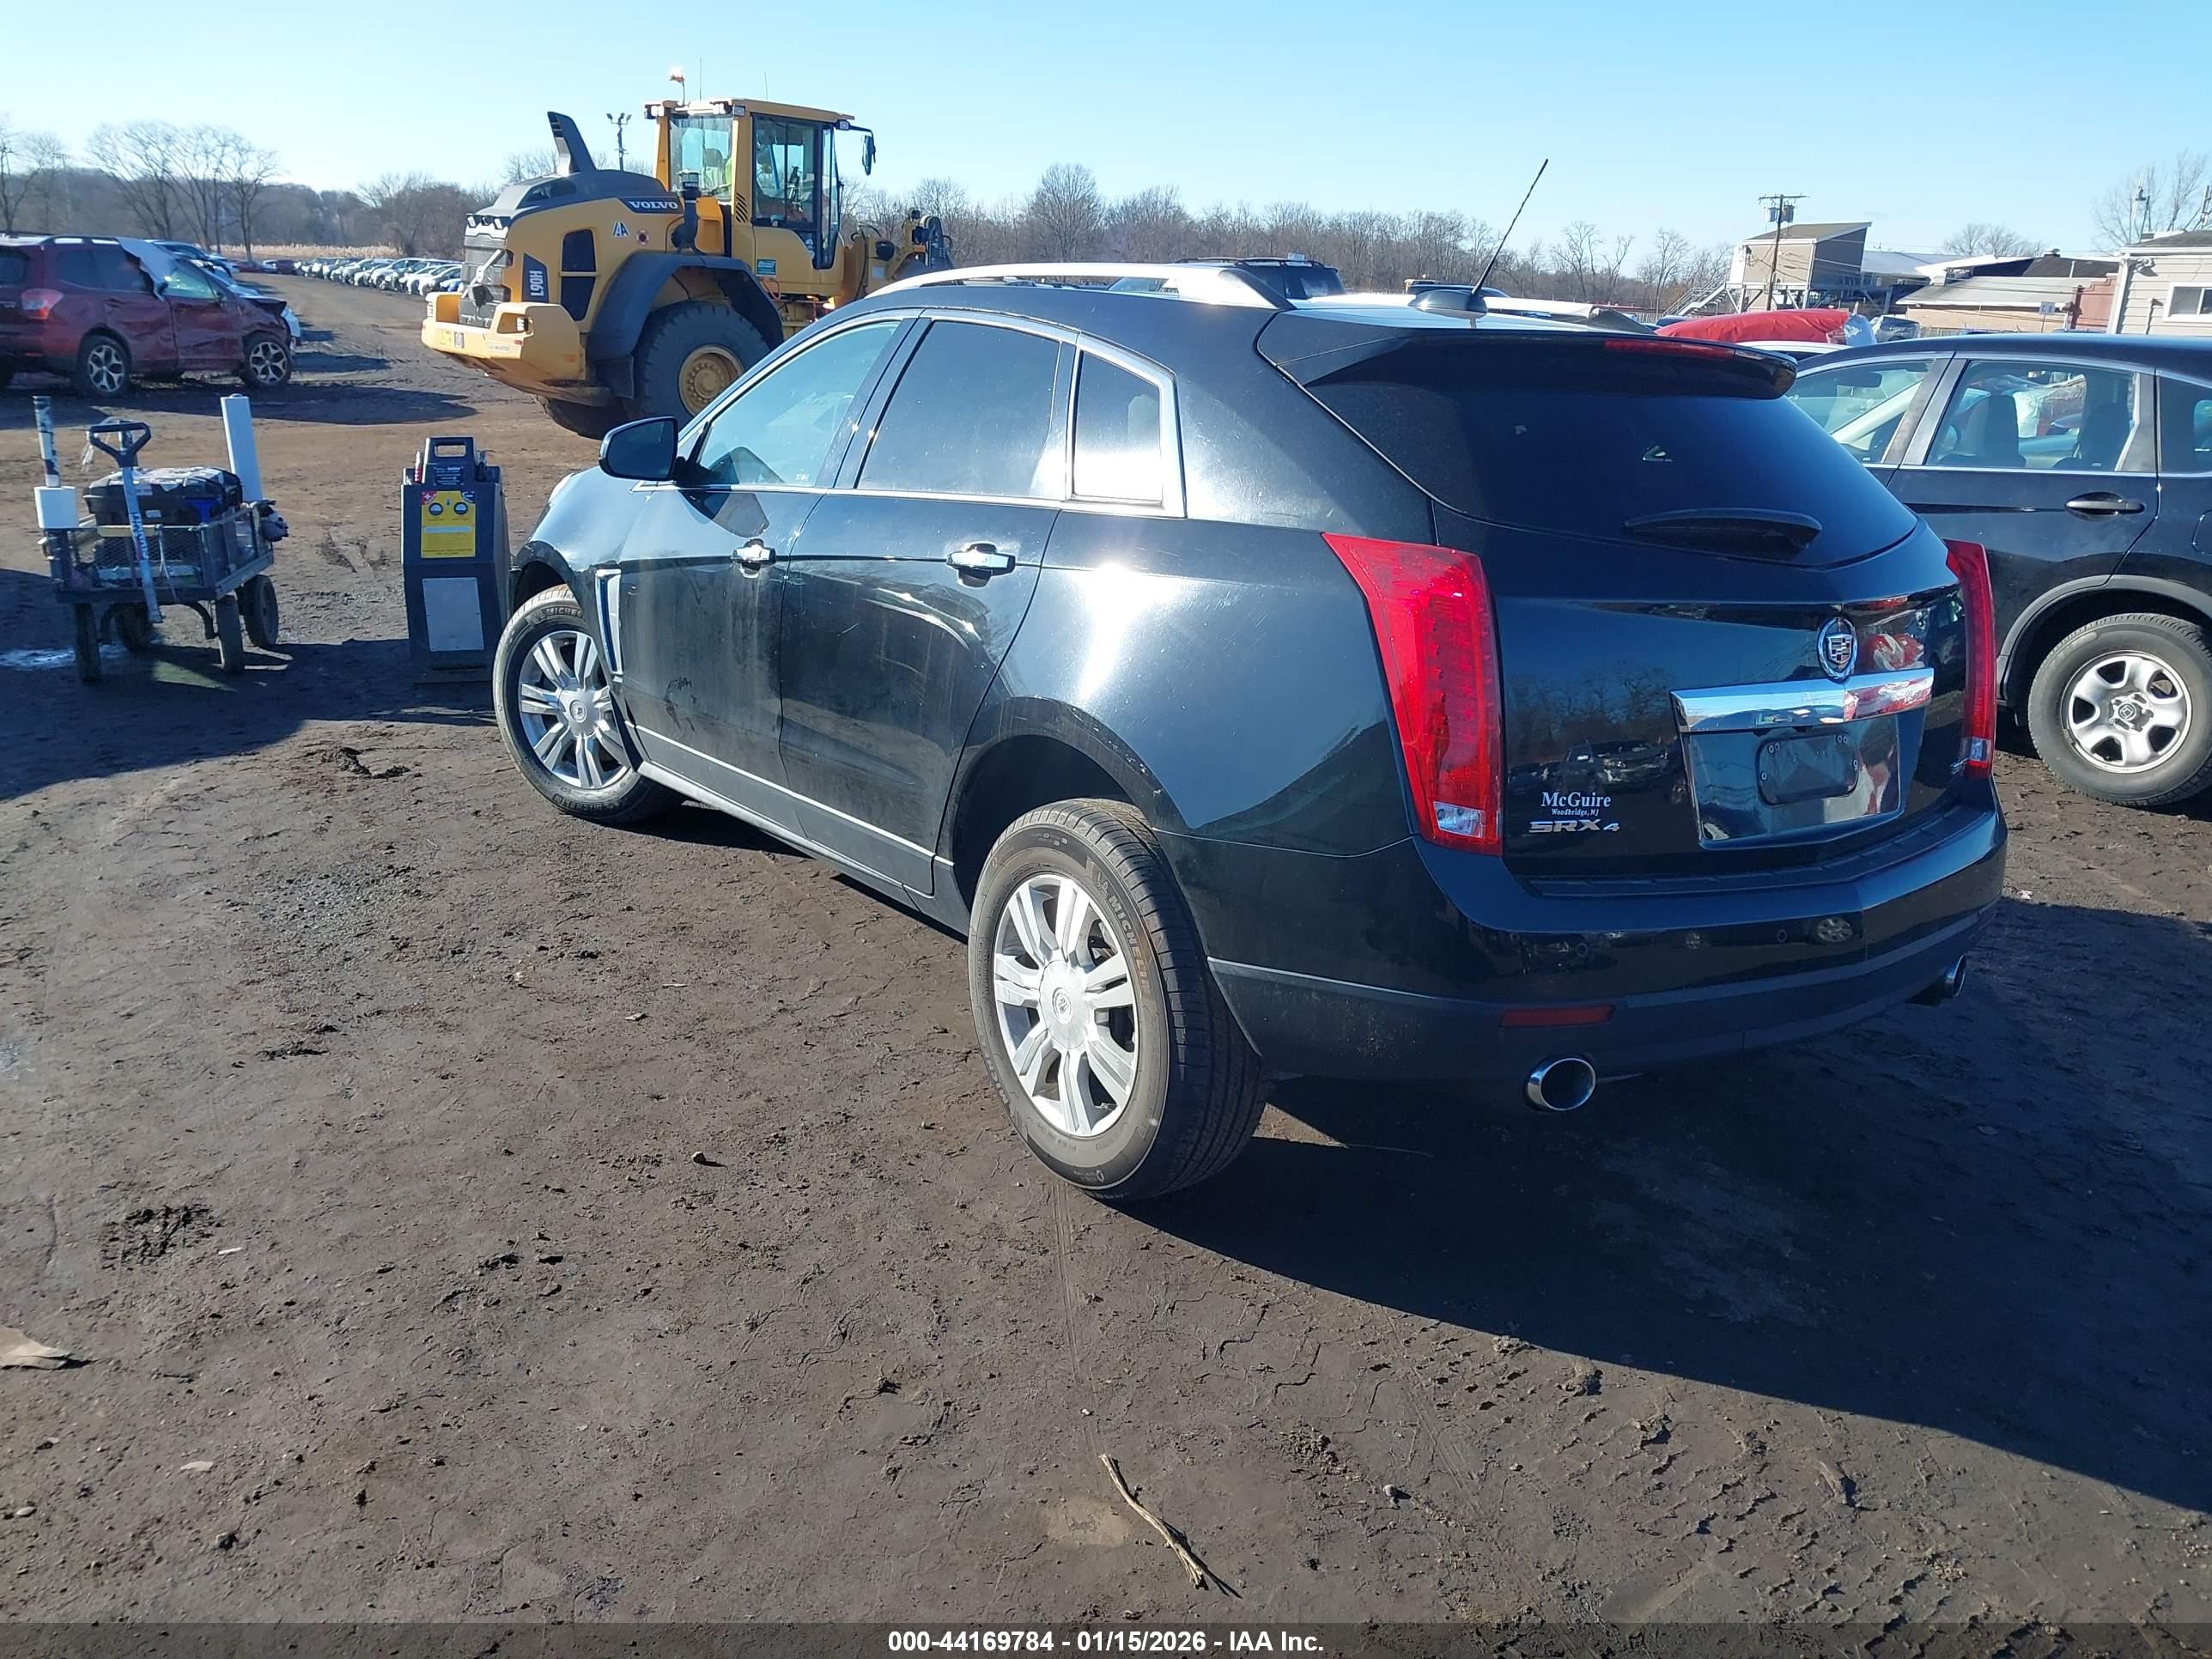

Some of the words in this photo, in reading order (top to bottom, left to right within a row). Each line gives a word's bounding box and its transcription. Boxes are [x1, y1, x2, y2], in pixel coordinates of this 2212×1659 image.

[629, 201, 678, 210] VOLVO
[528, 270, 544, 296] L90H
[1540, 792, 1612, 807] McGuire
